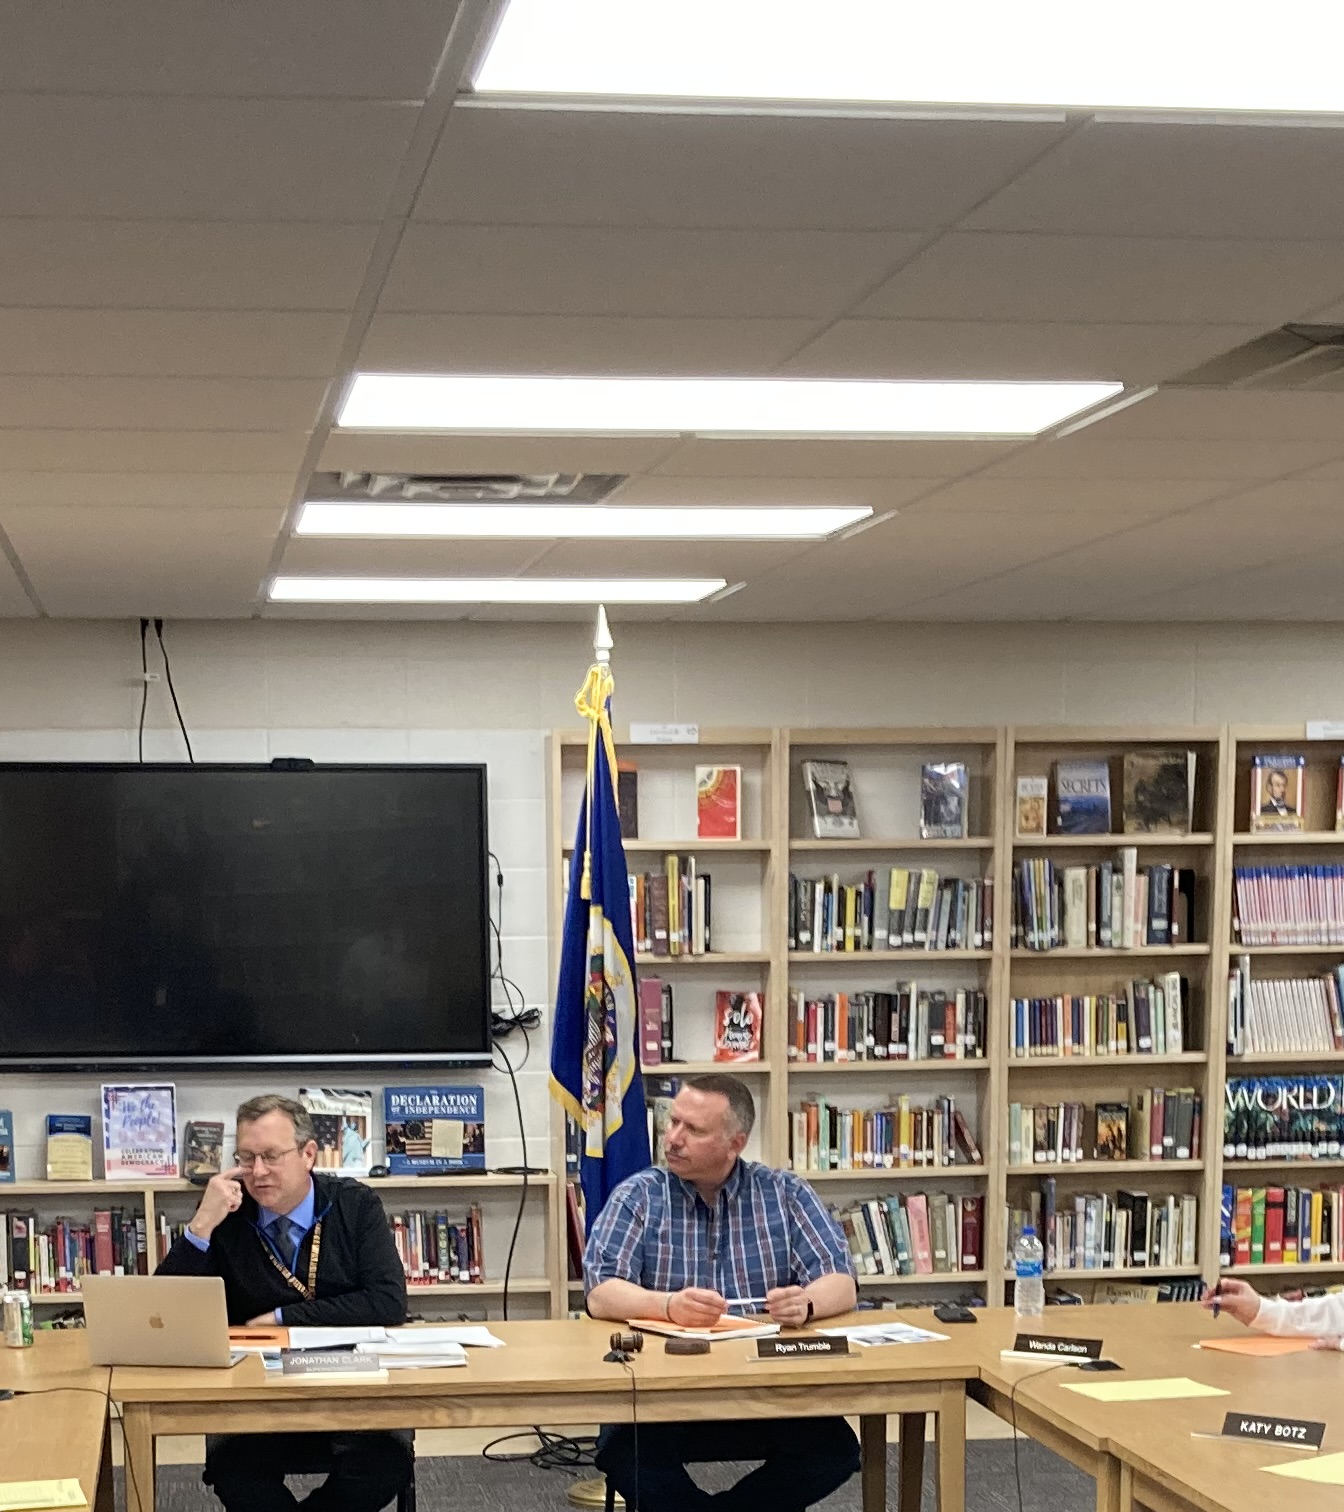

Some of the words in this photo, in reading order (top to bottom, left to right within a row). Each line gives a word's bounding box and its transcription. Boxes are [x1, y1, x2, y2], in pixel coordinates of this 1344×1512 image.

[391, 1094, 478, 1107] DECLARATION
[1224, 1081, 1336, 1112] WORLD
[404, 1106, 478, 1115] INDEPENDENCE
[775, 1342, 797, 1354] Ryan
[798, 1341, 831, 1351] Trumble
[1028, 1339, 1056, 1351] Wanda
[1057, 1342, 1088, 1353] Carlson
[290, 1355, 340, 1366] JONATHAN
[341, 1355, 374, 1364] CLARK
[1240, 1420, 1272, 1435] KATY
[1274, 1424, 1307, 1440] BOTZ
